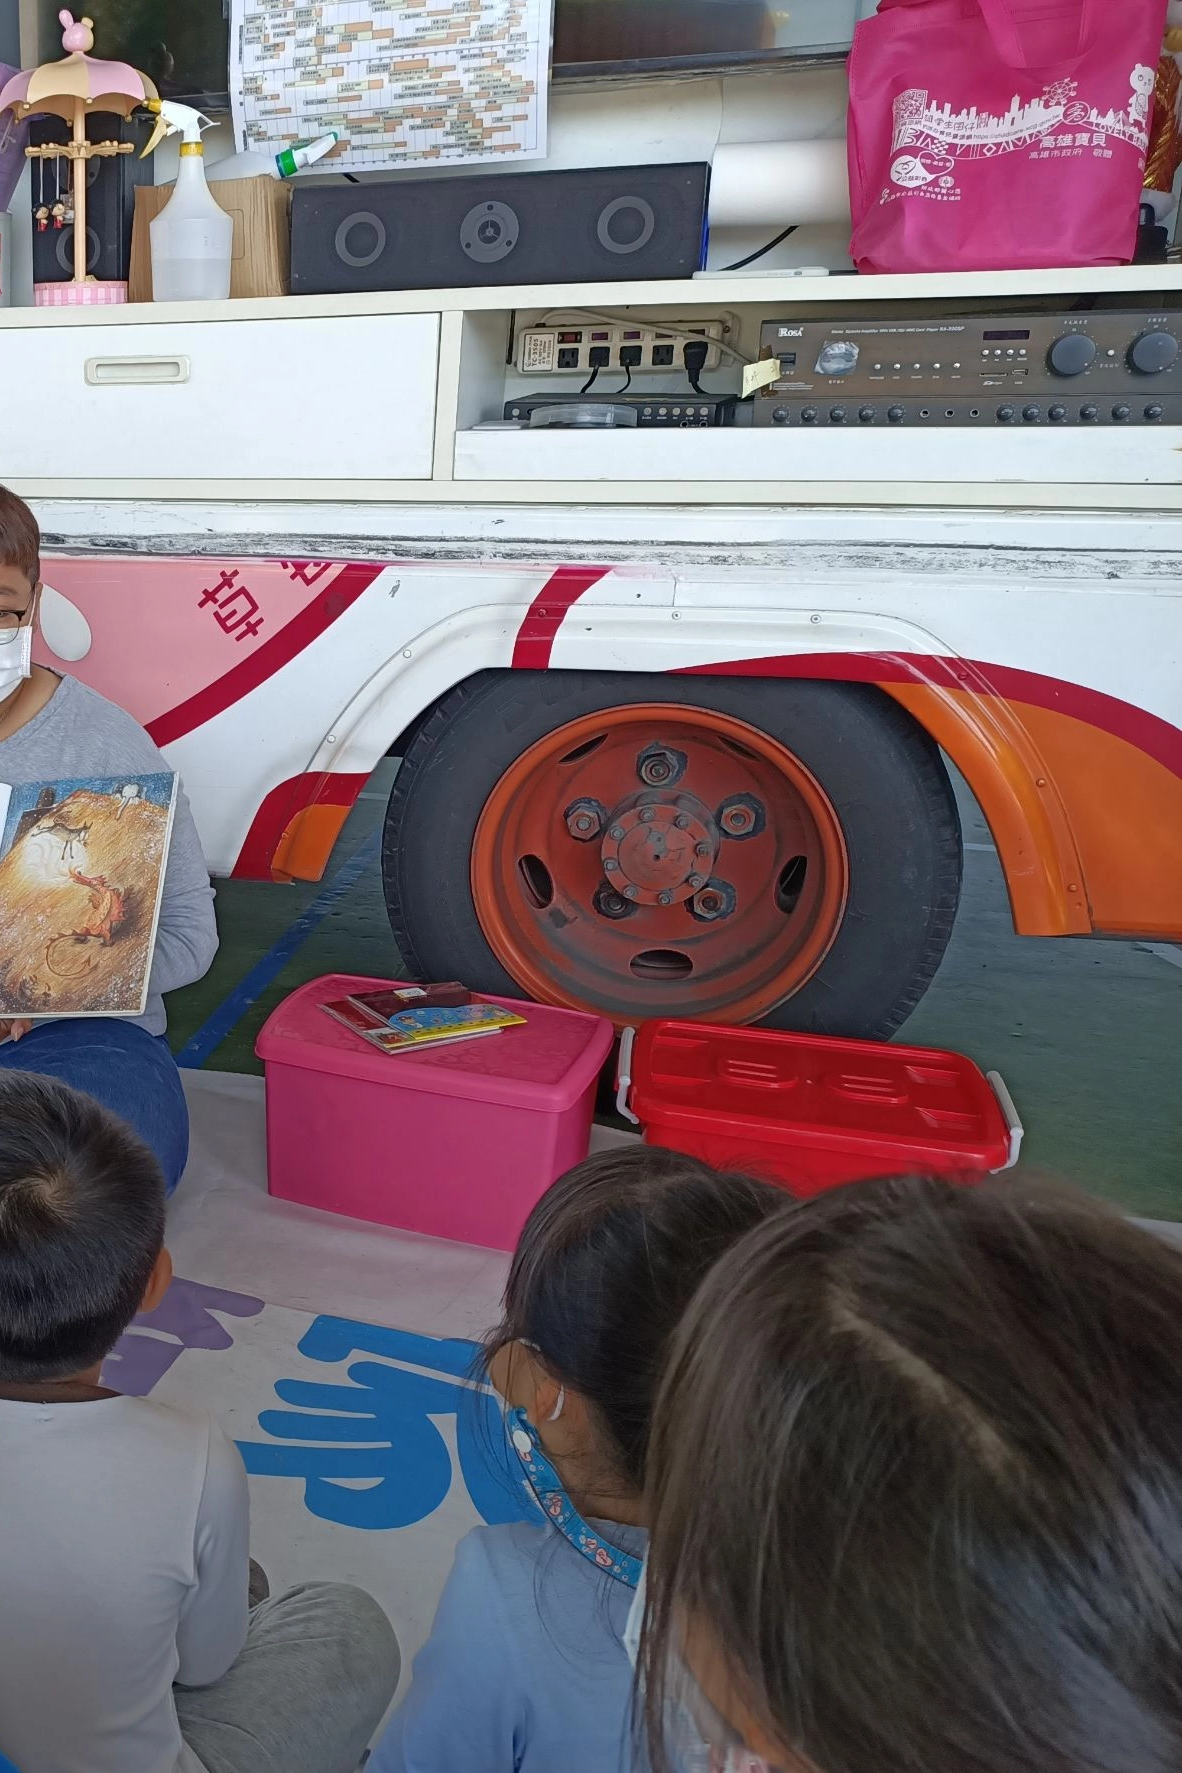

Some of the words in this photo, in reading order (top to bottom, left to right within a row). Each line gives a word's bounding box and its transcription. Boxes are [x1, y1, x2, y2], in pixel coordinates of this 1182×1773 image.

[1039, 132, 1107, 149] 高雄寶貝
[1028, 148, 1083, 160] 高雄市政府
